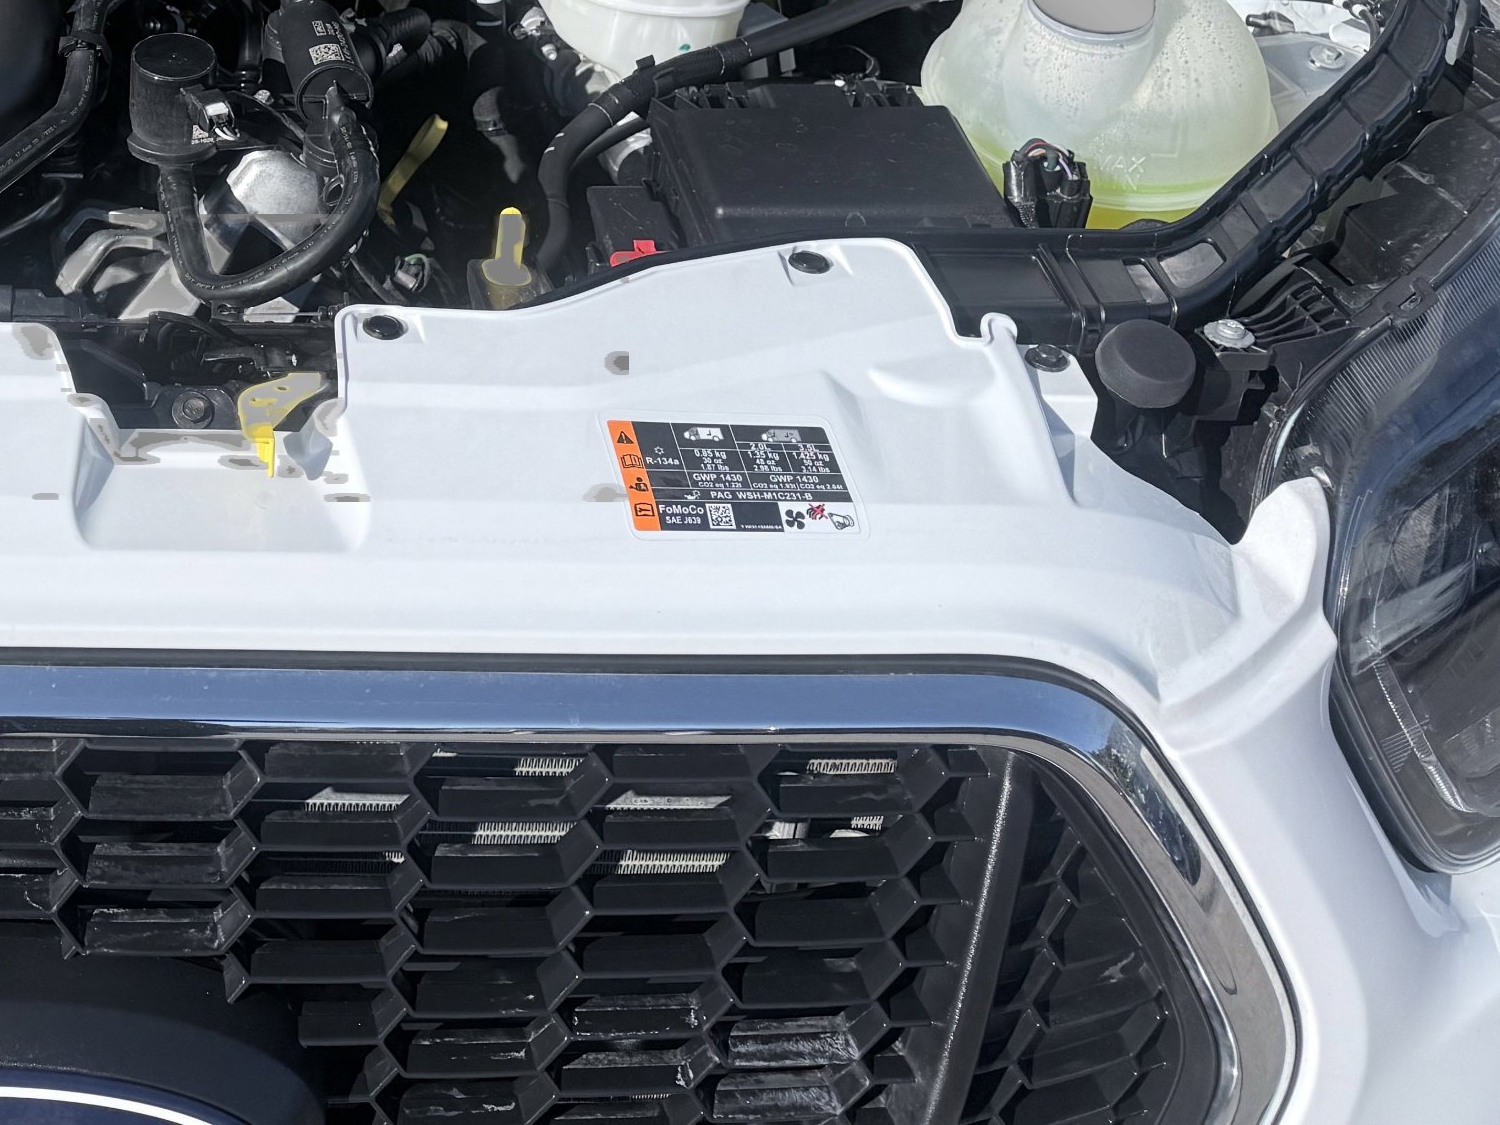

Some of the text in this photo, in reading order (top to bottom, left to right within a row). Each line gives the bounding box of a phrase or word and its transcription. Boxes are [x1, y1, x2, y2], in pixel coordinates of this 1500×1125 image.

[750, 443, 771, 451] 2.0L
[798, 444, 819, 452] 3.5L
[694, 449, 727, 459] 0.85 kg
[748, 450, 780, 461] 1.35 kg
[792, 451, 829, 462] 1.425 kg
[645, 456, 680, 465] R-134a
[692, 473, 743, 482] GWP 1430
[769, 475, 819, 483] GWP 1430
[710, 491, 733, 499] PAG
[658, 504, 704, 514] FoMoCo
[665, 516, 683, 524] SAE
